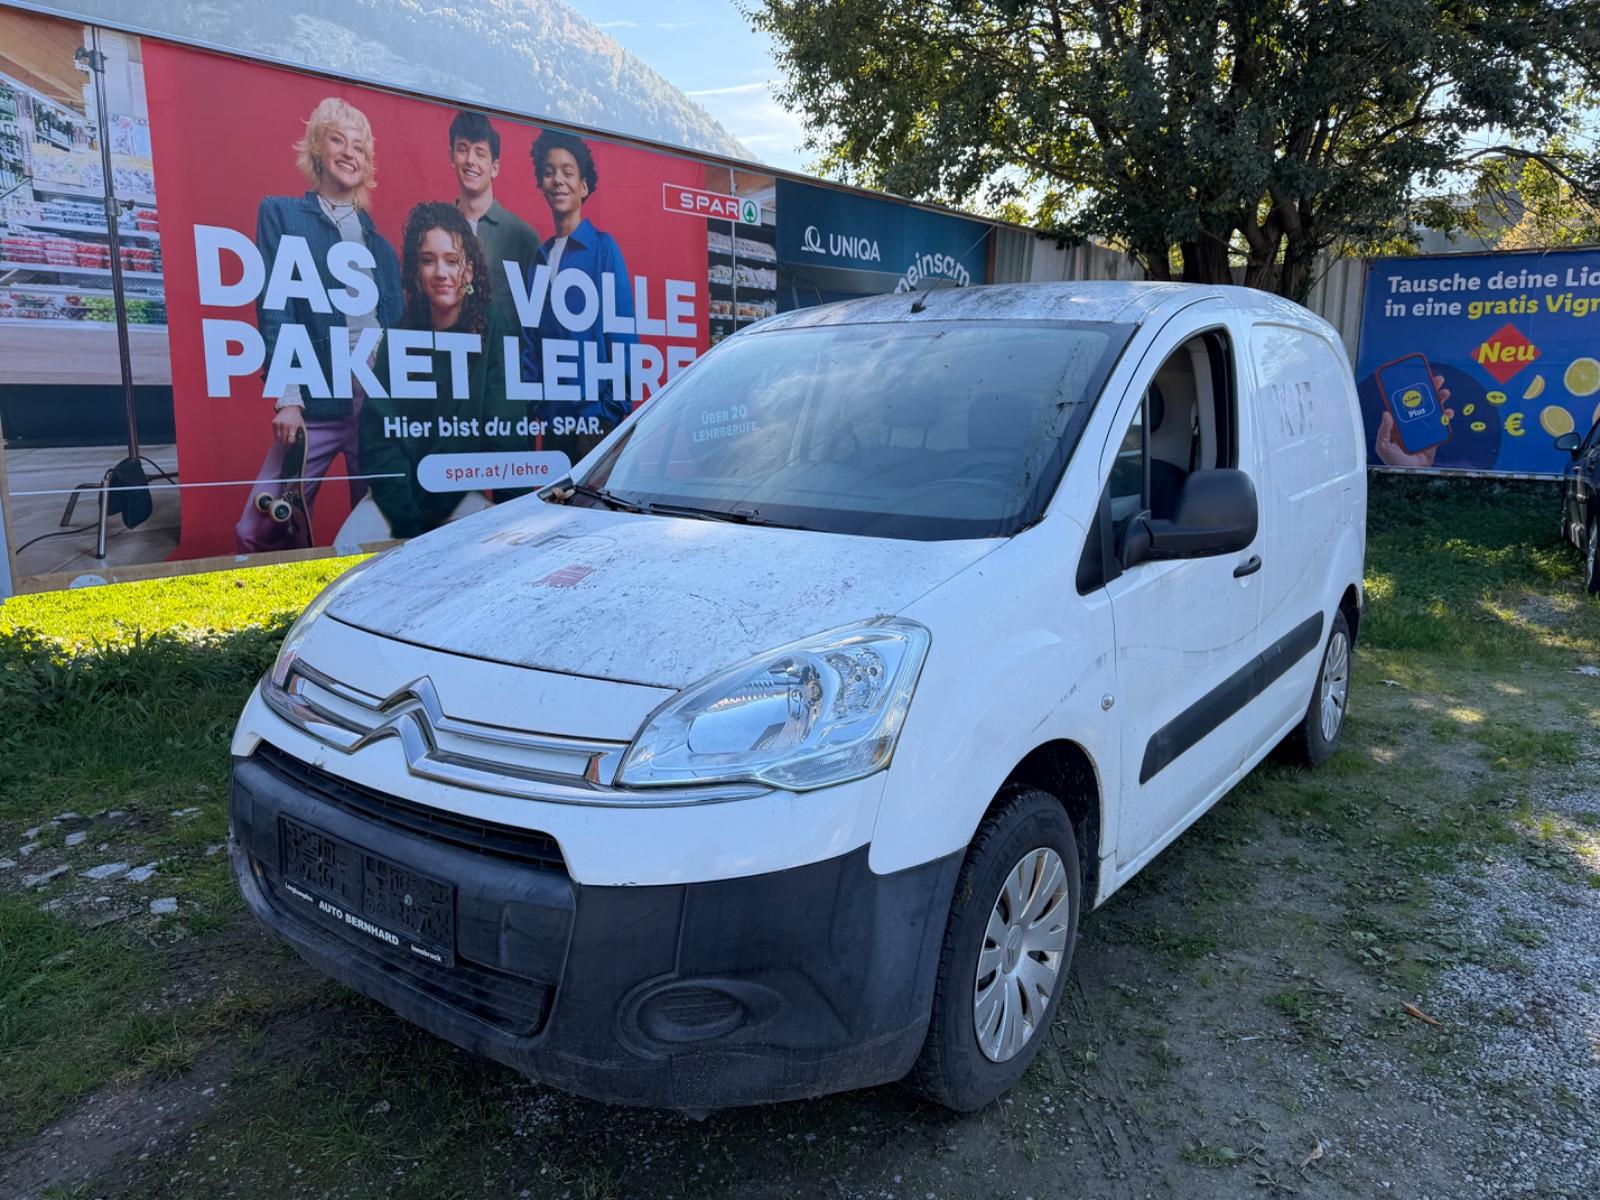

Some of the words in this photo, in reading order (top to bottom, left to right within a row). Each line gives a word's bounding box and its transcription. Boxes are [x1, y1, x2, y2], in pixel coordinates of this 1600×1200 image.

[680, 193, 738, 217] SPAR
[829, 234, 880, 262] UNIQA
[194, 224, 379, 316] DAS
[502, 260, 697, 338] VOLLE
[1388, 273, 1480, 293] Tausche
[1487, 269, 1558, 290] deine
[1385, 299, 1406, 317] in
[1412, 298, 1462, 317] eine
[1468, 294, 1538, 319] gratis
[202, 318, 482, 399] PAKET
[1477, 342, 1535, 364] Neu
[702, 410, 729, 425] ÜBER
[731, 404, 747, 420] 20
[1408, 408, 1426, 418] Plus
[384, 415, 432, 438] Hier
[438, 415, 479, 437] bist
[485, 416, 511, 437] du
[516, 416, 548, 436] der
[553, 416, 604, 436] SPAR.
[445, 462, 549, 482] spar.at/lehre
[319, 900, 343, 919] AUTO
[345, 913, 399, 945] BERNHARD
